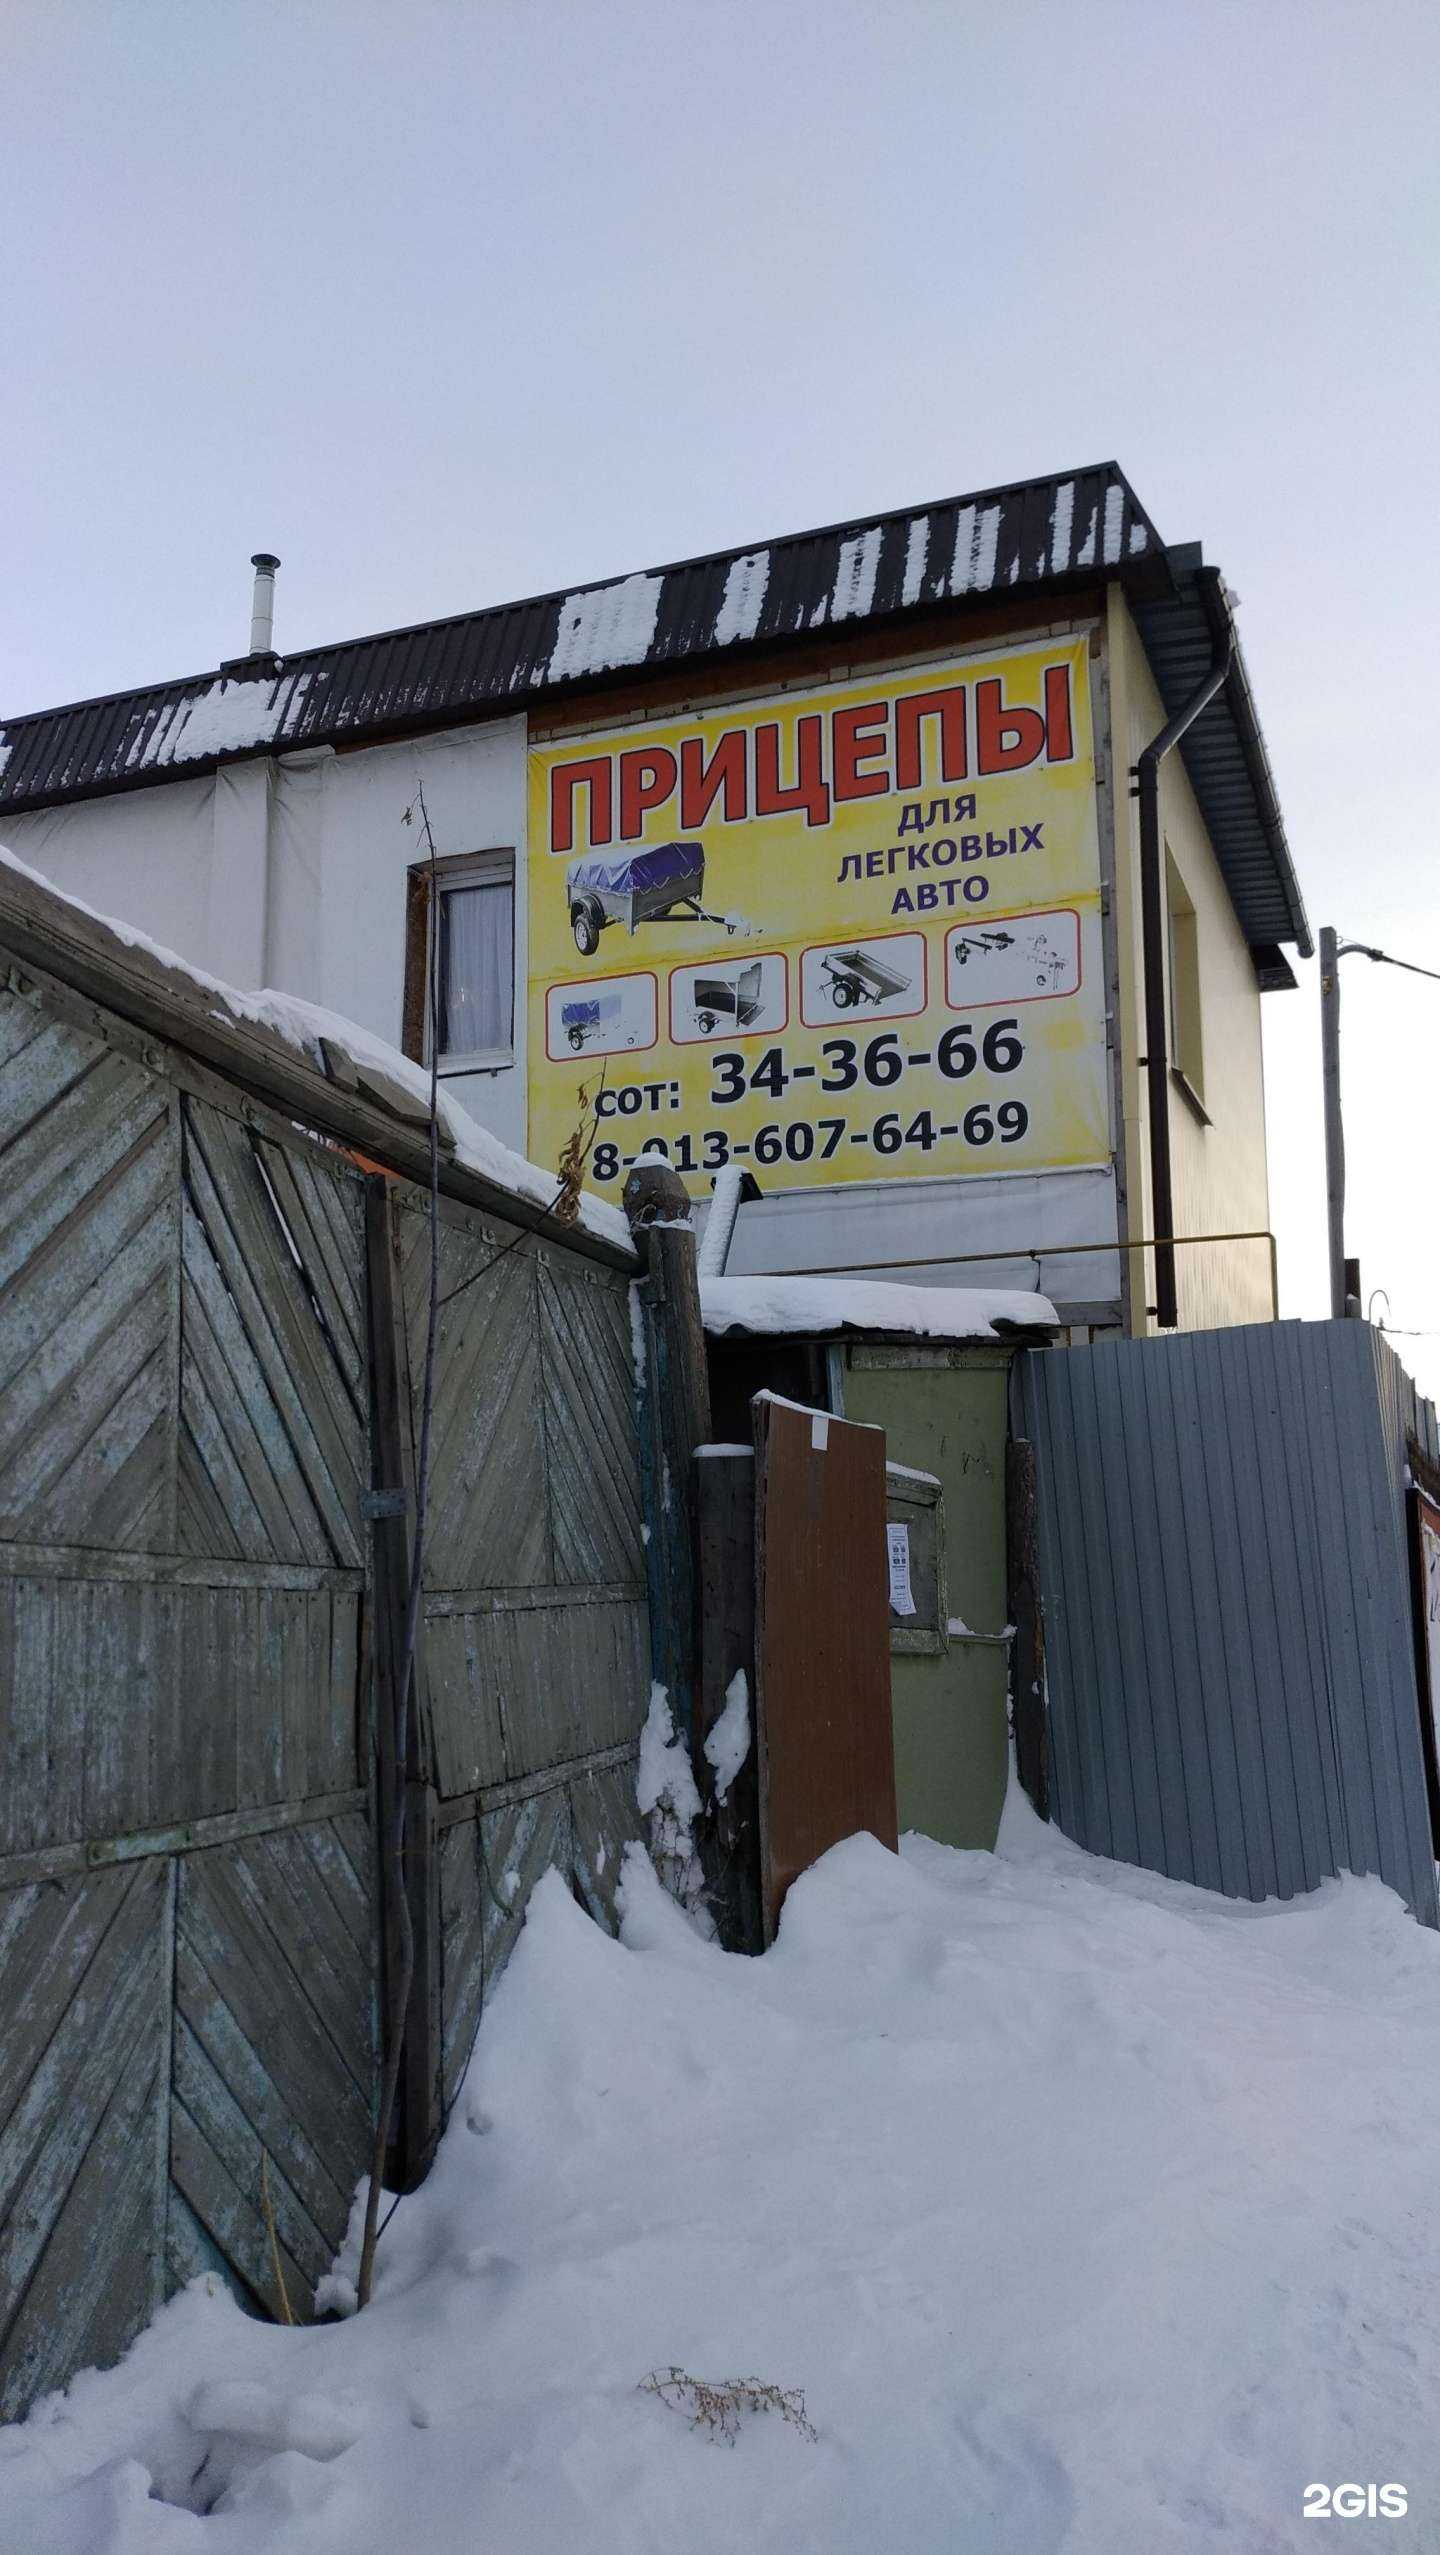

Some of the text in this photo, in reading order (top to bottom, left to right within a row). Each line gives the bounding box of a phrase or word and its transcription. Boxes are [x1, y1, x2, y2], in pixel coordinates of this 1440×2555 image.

[551, 664, 1073, 852] ПРИЦЕПЫ
[898, 794, 977, 836] ДЛЯ
[837, 823, 1045, 883] ЛЕГКОВЫХ
[891, 875, 989, 914] АВТО
[711, 1019, 1023, 1103] 34-36-66
